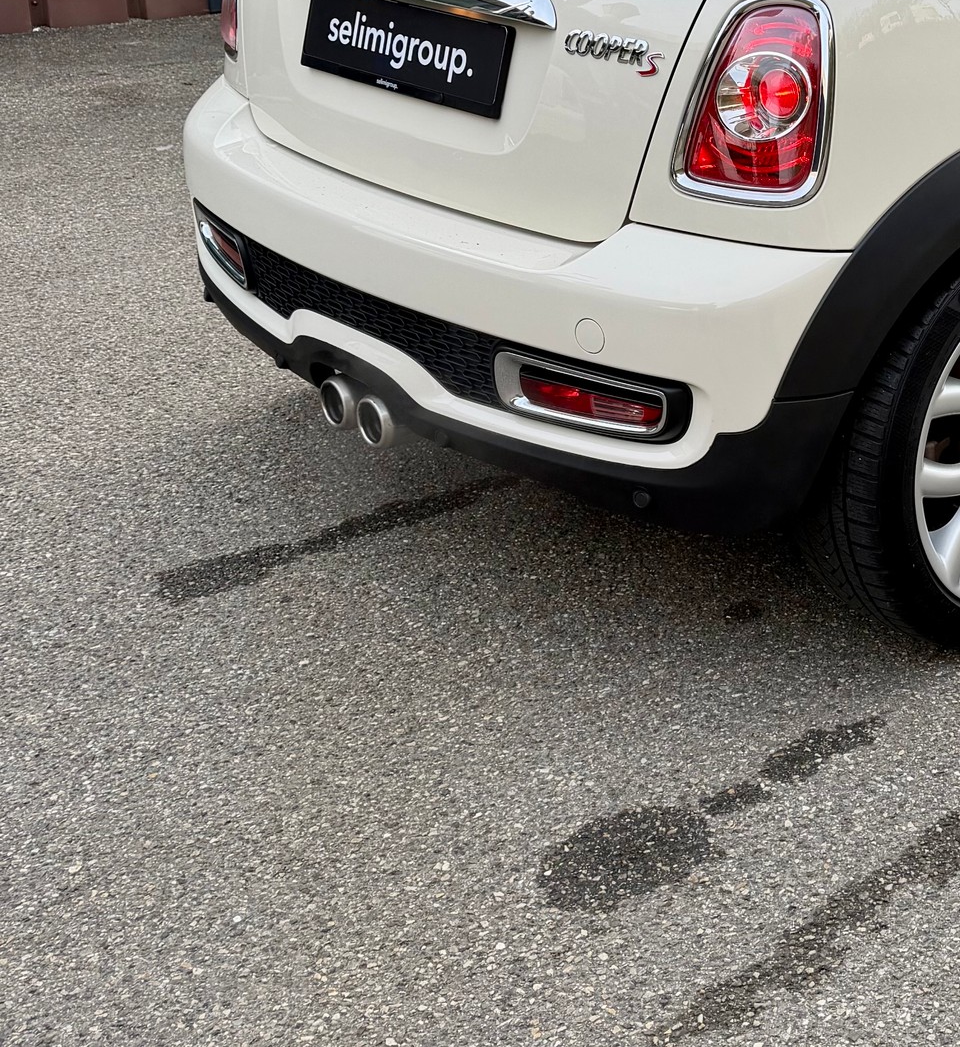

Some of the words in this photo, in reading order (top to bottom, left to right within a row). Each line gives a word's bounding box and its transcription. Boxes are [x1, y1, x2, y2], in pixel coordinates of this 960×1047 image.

[327, 11, 473, 83] selimigroup.
[564, 29, 649, 66] COOPER
[635, 52, 665, 77] S
